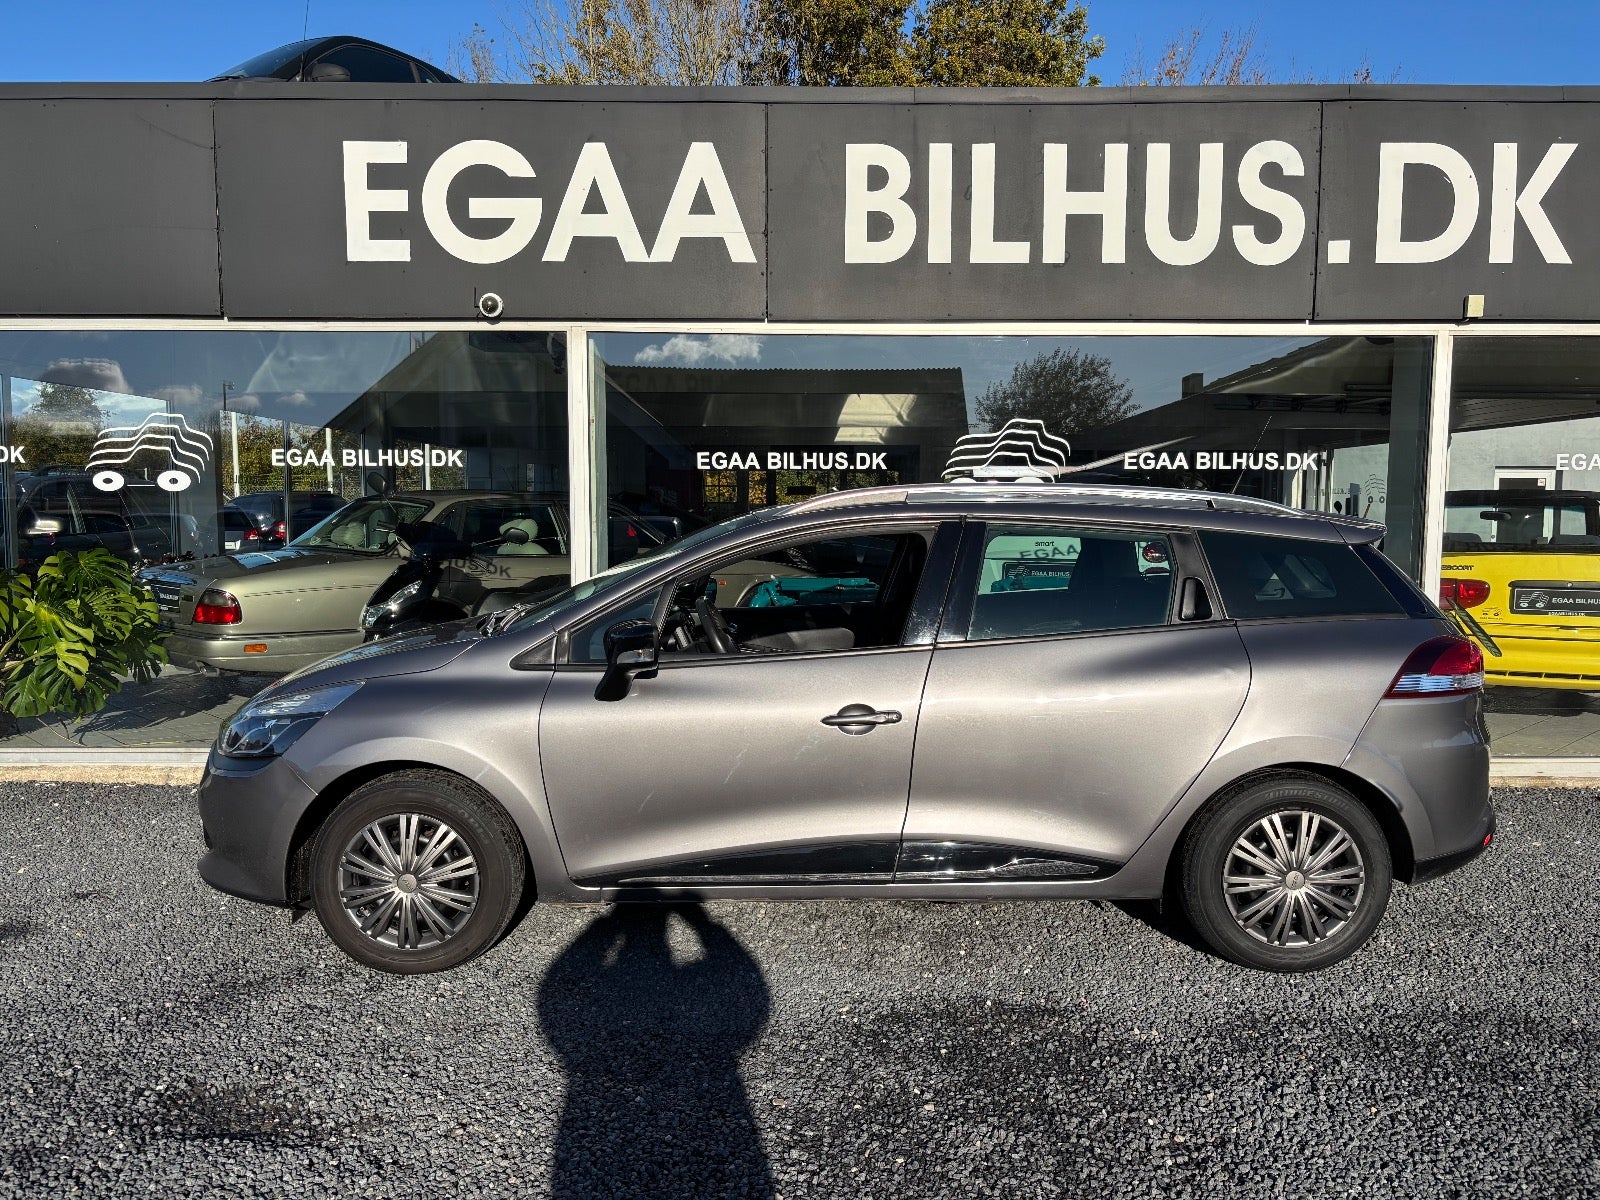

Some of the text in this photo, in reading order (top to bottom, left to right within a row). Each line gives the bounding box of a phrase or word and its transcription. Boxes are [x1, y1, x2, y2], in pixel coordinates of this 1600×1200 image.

[342, 139, 1579, 266] EGAA BILHUS.DK
[271, 448, 464, 468] EGAA BILHUS.DK
[696, 451, 888, 470] EGAA BILHUS.DK
[1123, 451, 1319, 471] EGAA BILHUS.DK
